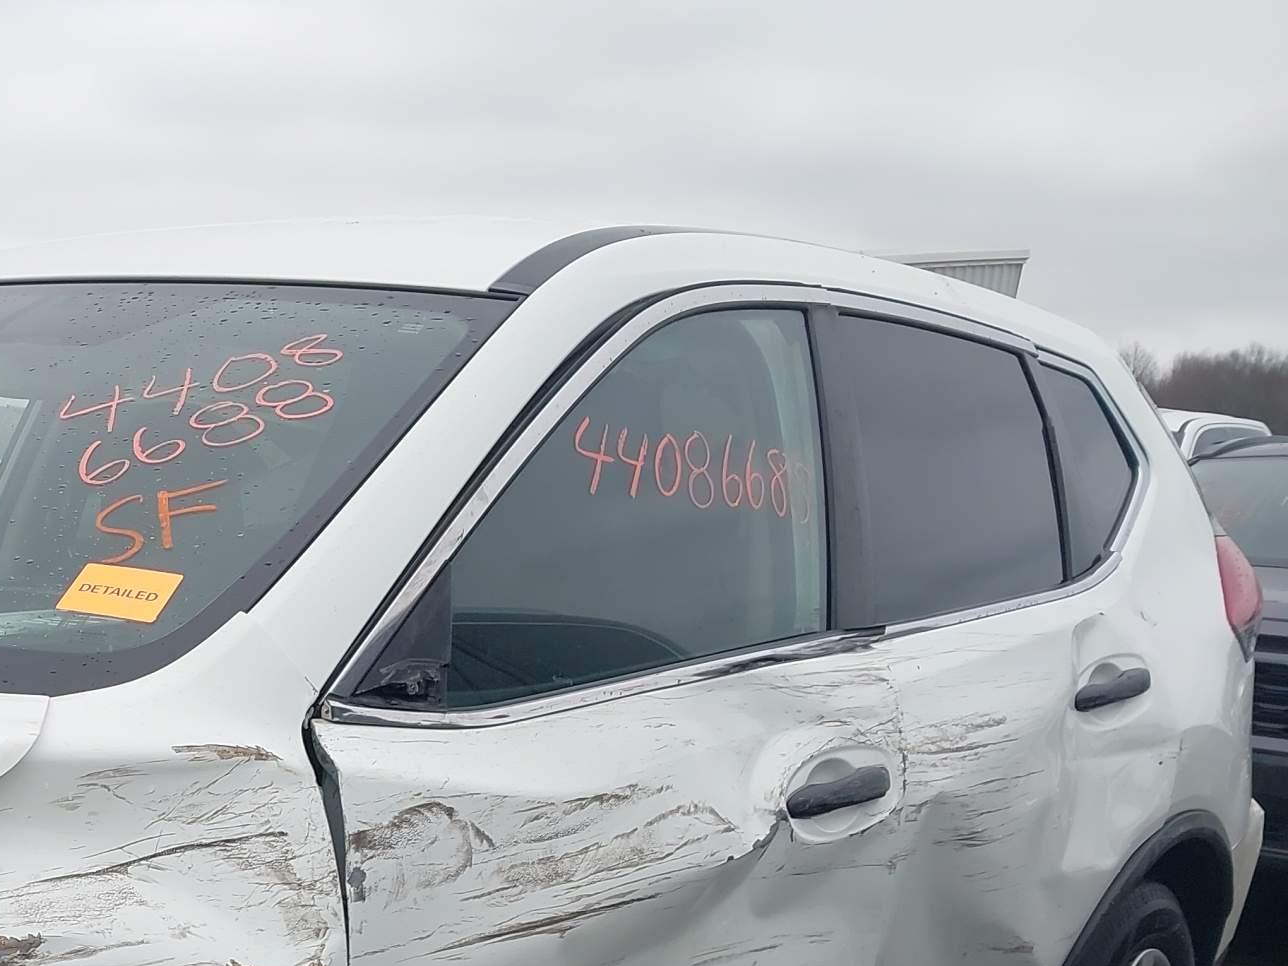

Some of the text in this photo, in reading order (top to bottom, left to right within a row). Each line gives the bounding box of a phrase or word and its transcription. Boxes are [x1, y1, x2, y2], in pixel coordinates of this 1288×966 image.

[77, 378, 335, 485] 6688
[95, 479, 229, 564] SF
[78, 582, 159, 603] DETAILED
